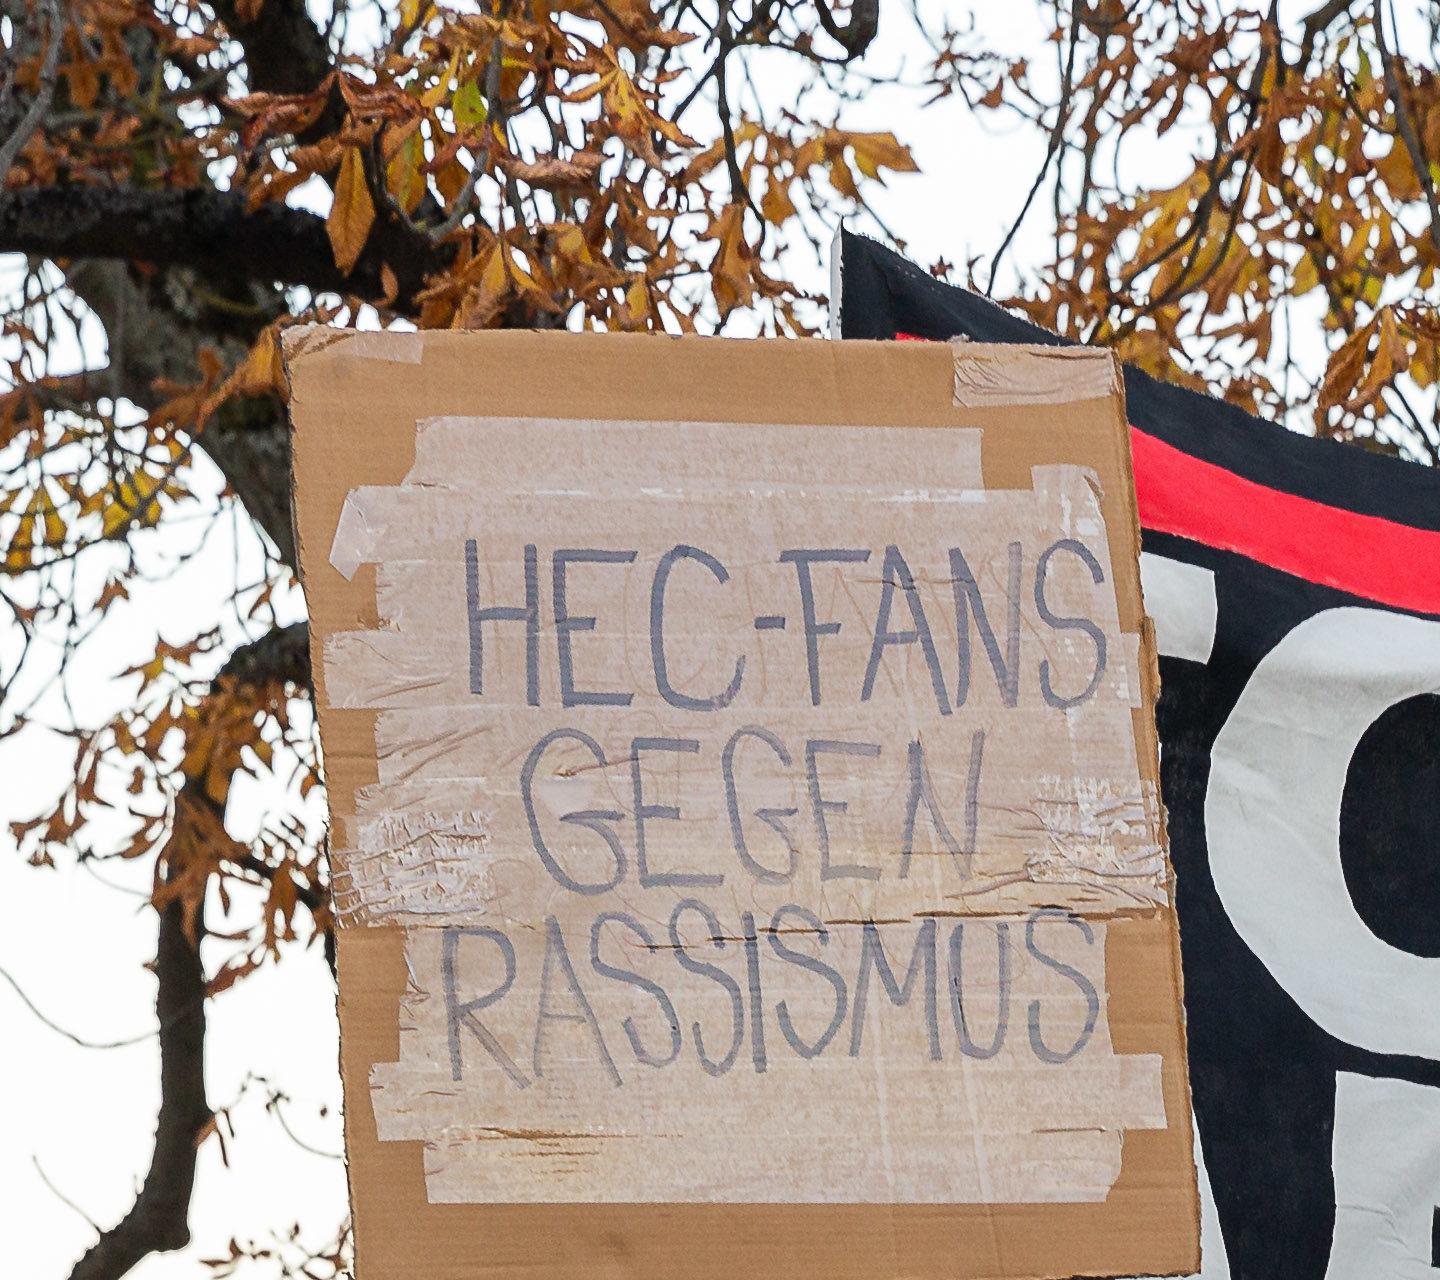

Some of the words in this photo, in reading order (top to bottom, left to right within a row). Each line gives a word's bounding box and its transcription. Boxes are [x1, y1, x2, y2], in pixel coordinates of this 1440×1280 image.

[466, 538, 1106, 714] HEC-FANS
[520, 725, 985, 897] GEGEN
[443, 899, 1102, 1089] RASSISMUS
